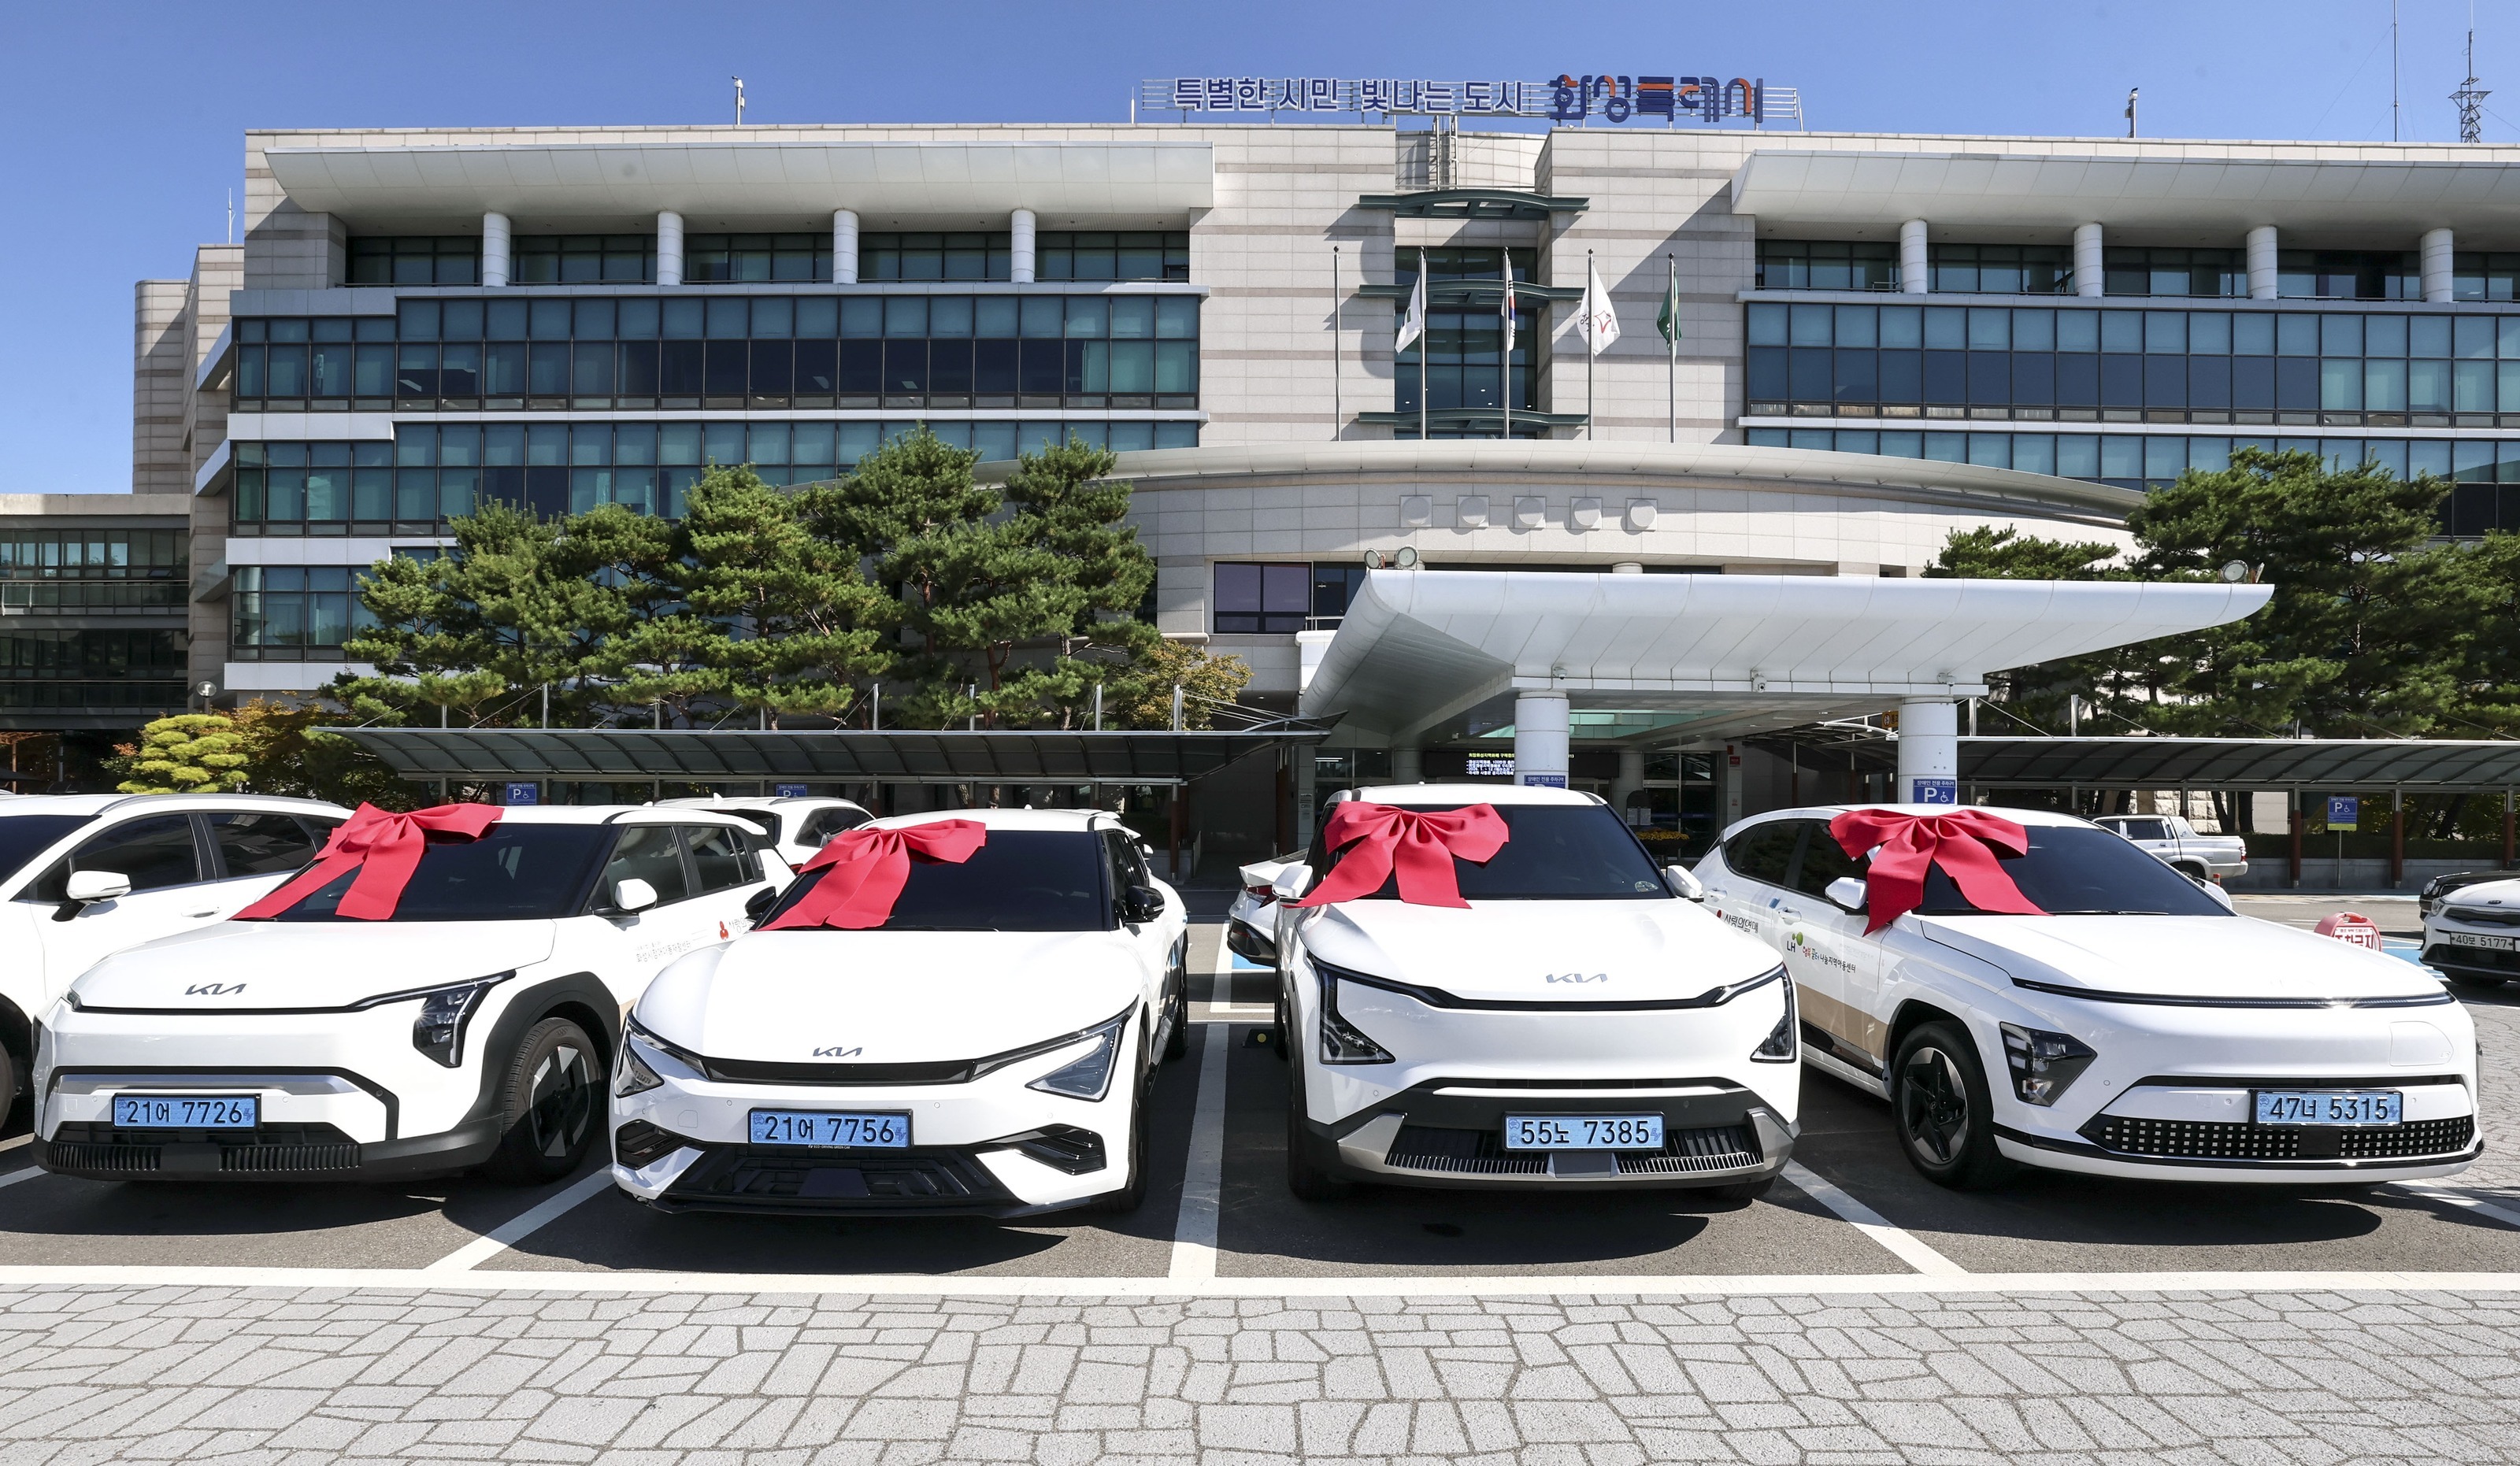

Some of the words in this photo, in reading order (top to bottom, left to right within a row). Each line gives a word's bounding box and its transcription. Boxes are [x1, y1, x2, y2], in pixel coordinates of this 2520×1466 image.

[1174, 76, 1267, 111] 특별한
[1277, 76, 1339, 111] 시민
[1361, 77, 1455, 113] 빛나는
[1462, 80, 1522, 113] 도시
[1549, 74, 1763, 123] 화성특례시
[513, 789, 521, 799] P
[1924, 787, 1937, 802] P
[2335, 802, 2343, 813] P
[1724, 913, 1758, 934] 사랑의열매
[2456, 935, 2475, 945] 40보
[2481, 936, 2507, 949] 5177
[1787, 940, 1796, 953] LH
[1820, 953, 1856, 973] 나눔지역아동센터
[1546, 973, 1608, 983] KIA
[184, 983, 247, 995] KIA
[812, 1046, 863, 1057] KIA
[127, 1101, 170, 1124] 21어
[182, 1101, 243, 1124] 7726
[2270, 1096, 2316, 1119] 47너
[2329, 1096, 2388, 1120] 5315
[765, 1116, 814, 1141] 21어
[828, 1117, 895, 1142] 7756
[1521, 1120, 1570, 1144] 55노
[1583, 1120, 1650, 1144] 7385
